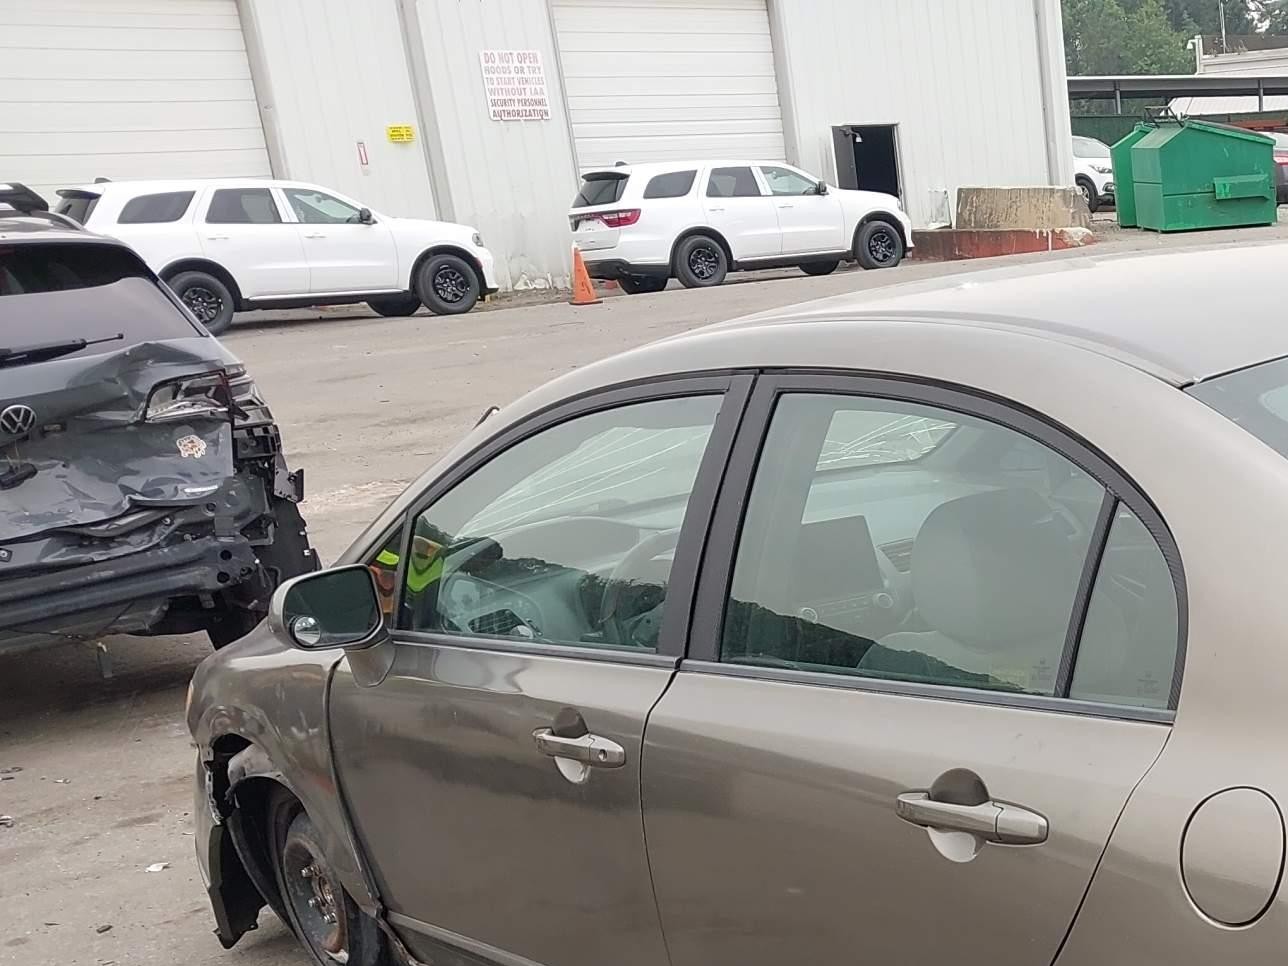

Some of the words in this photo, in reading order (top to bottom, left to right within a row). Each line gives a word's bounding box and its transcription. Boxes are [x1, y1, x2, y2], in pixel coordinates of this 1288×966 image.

[483, 52, 496, 64] DO
[497, 52, 515, 64] NOT
[516, 52, 539, 64] OPEN
[483, 65, 512, 75] HOODS
[513, 65, 526, 75] OR
[526, 65, 542, 75] TRY
[495, 77, 516, 86] START
[487, 87, 527, 97] WITHOUT
[490, 98, 516, 108] SECURITY
[516, 98, 548, 107] PERSONNEL
[492, 109, 549, 118] AUTHORIZATION
